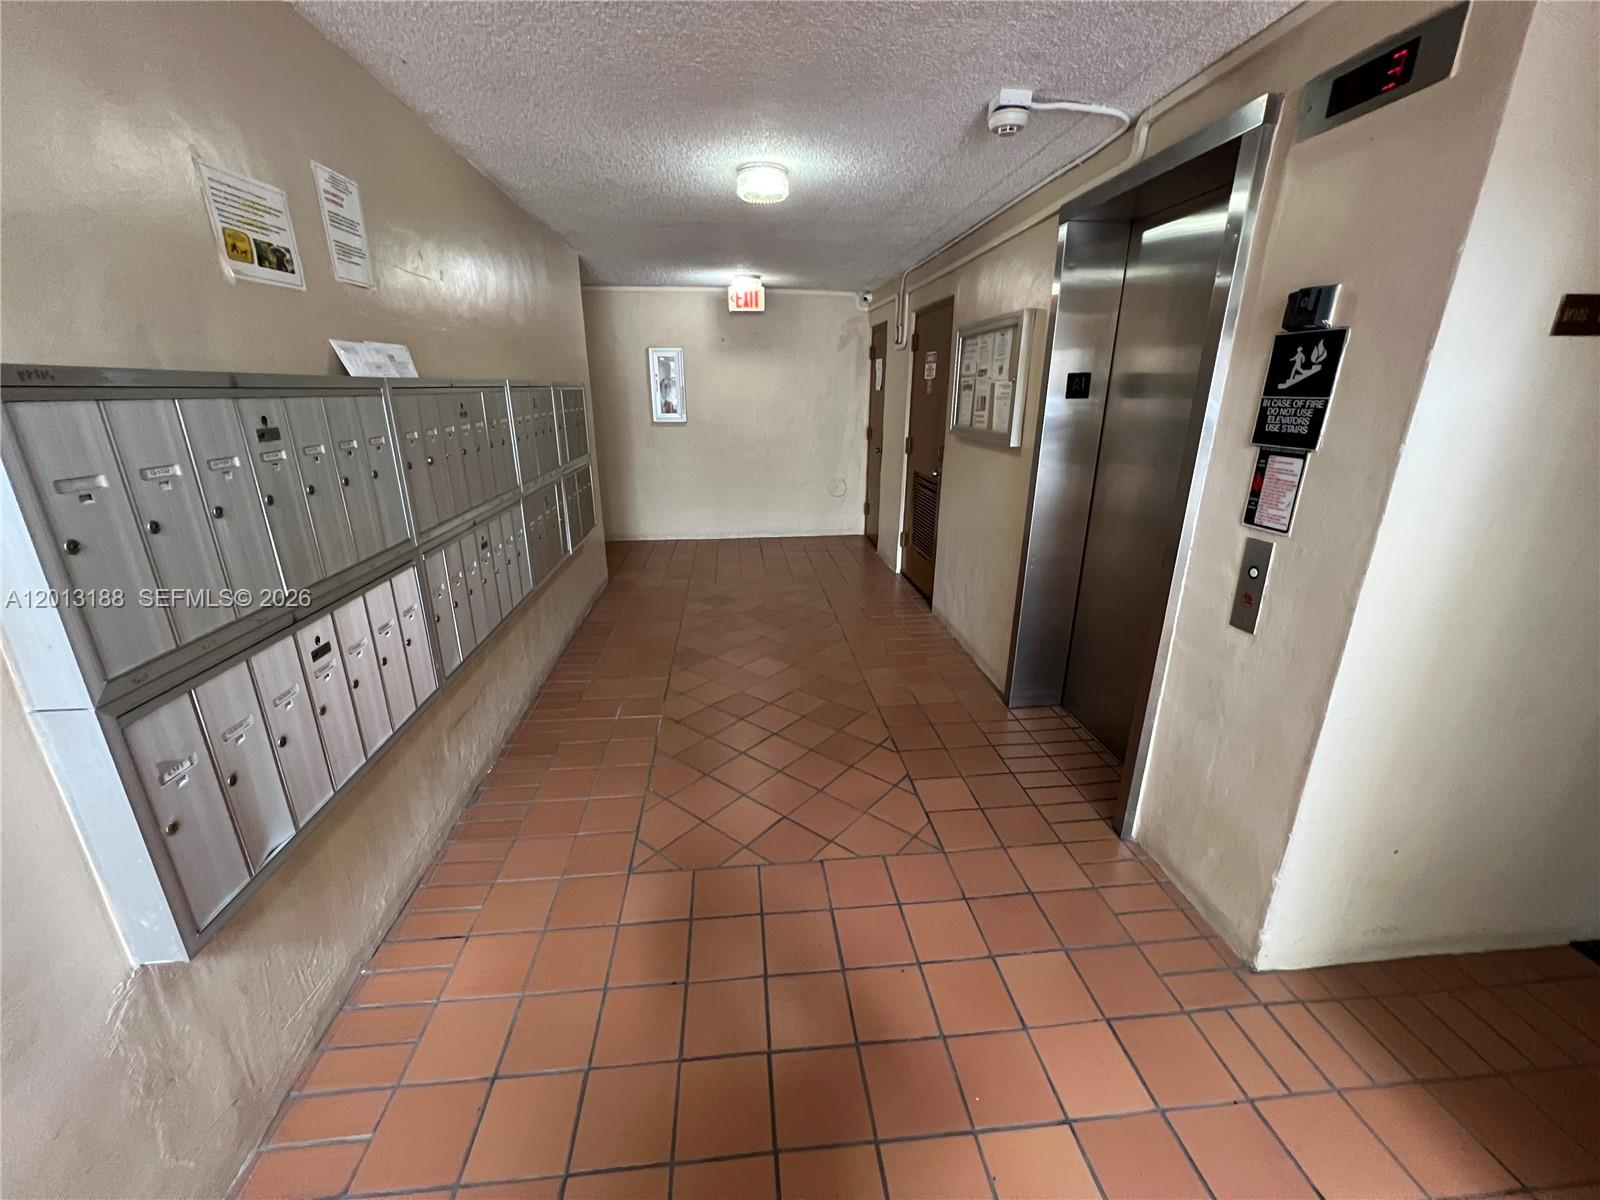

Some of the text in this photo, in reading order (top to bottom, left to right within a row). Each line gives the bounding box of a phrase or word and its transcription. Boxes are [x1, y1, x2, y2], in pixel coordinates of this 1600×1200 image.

[735, 290, 759, 308] EXIT
[1262, 399, 1325, 408] IN CASE OF FIRE
[1267, 407, 1314, 417] DO NOT USE
[1267, 416, 1310, 425] ELEVATORS
[1265, 424, 1308, 434] USE STAIRS
